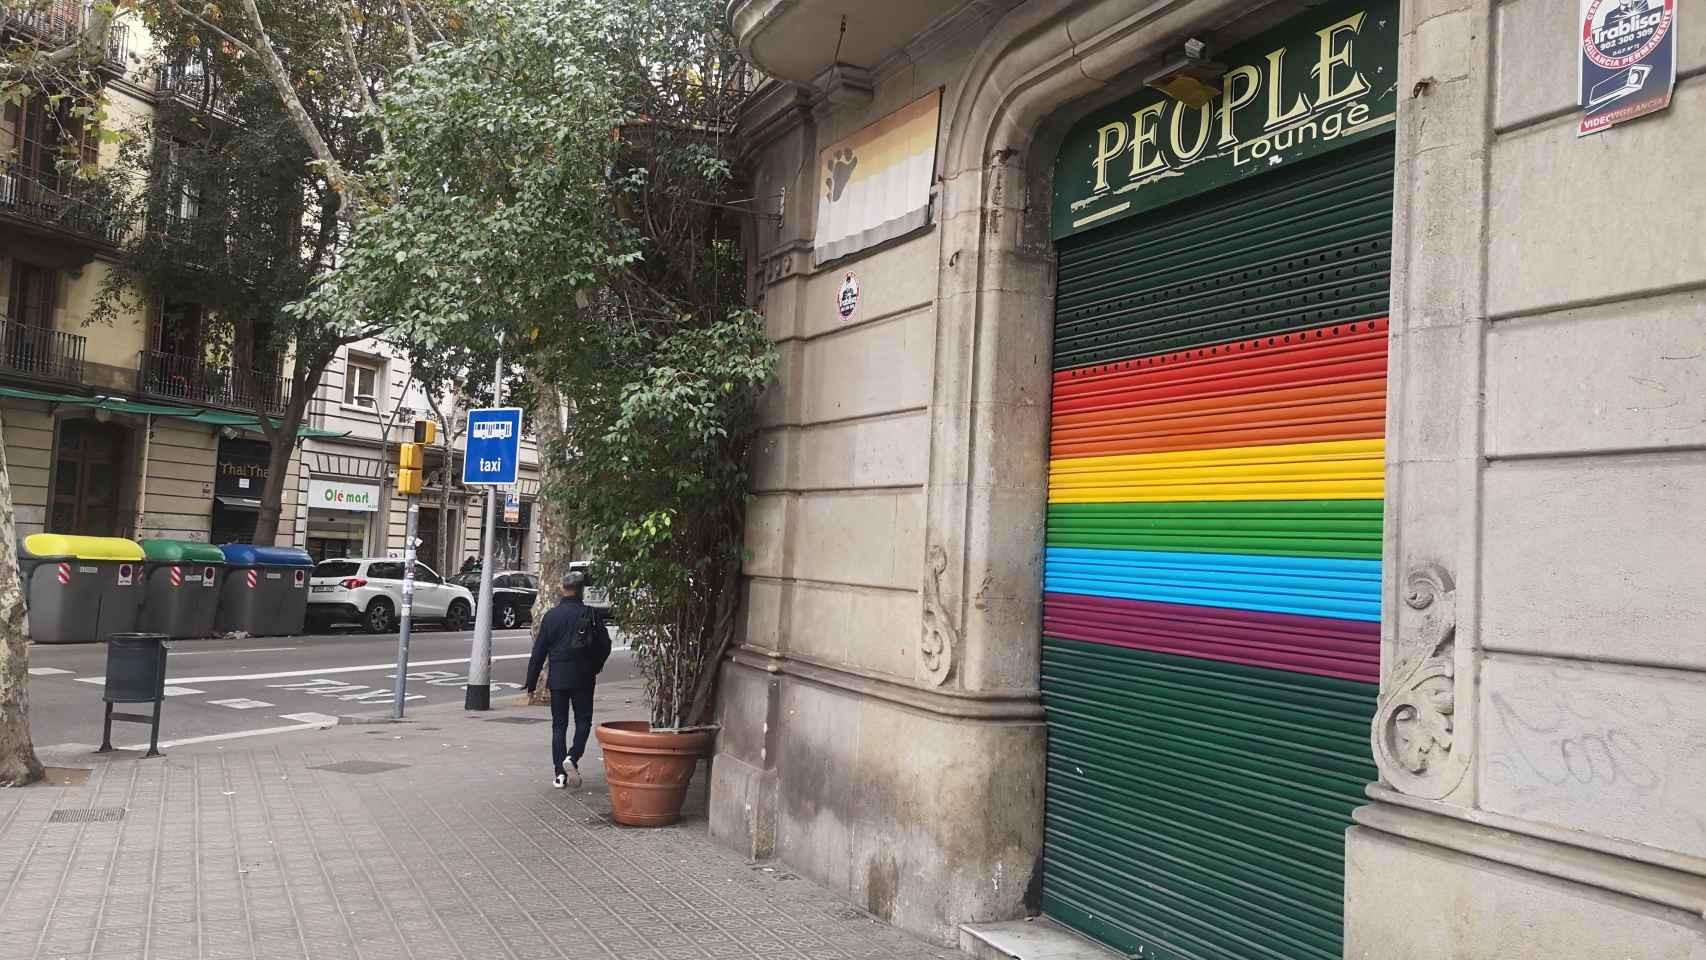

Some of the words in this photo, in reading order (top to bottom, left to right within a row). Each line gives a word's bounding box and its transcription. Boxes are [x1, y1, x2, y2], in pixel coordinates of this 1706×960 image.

[1592, 12, 1661, 44] Trablisa
[1584, 37, 1620, 66] VIGILANCIA
[1600, 40, 1616, 50] 902
[1618, 33, 1635, 44] 300
[1092, 10, 1371, 194] PEOPLE
[1233, 102, 1370, 167] Lounge
[248, 464, 271, 480] Tha
[480, 458, 501, 472] taxi
[346, 492, 369, 503] mart
